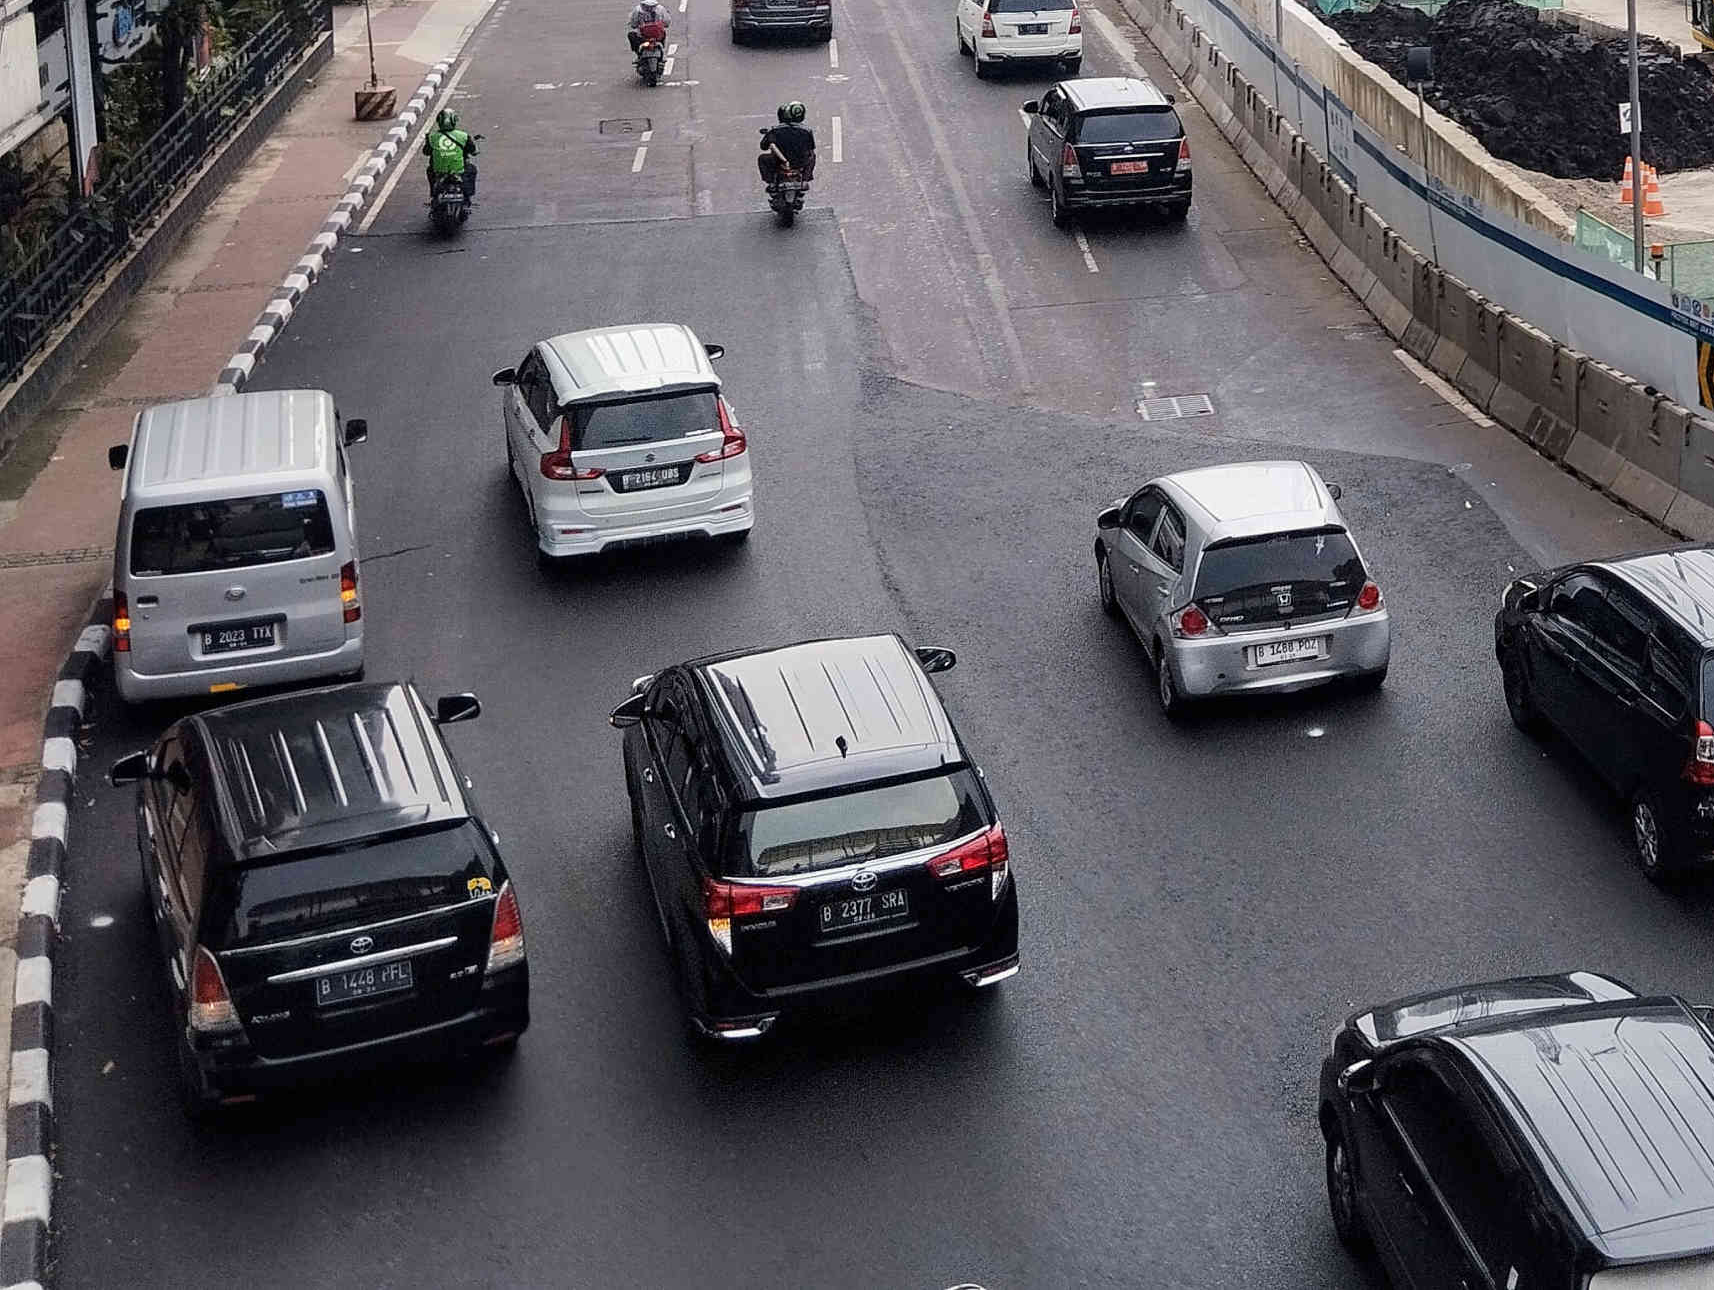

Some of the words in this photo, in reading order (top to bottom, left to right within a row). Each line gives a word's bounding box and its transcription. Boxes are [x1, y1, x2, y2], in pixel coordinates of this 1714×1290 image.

[204, 633, 212, 646] B
[219, 629, 245, 644] 2023
[1258, 646, 1264, 658] B
[823, 905, 832, 923] B
[841, 897, 873, 919] 2377
[881, 891, 905, 909] SRA
[321, 978, 331, 996] B
[342, 969, 375, 991] 1448
[382, 962, 408, 983] PFL
